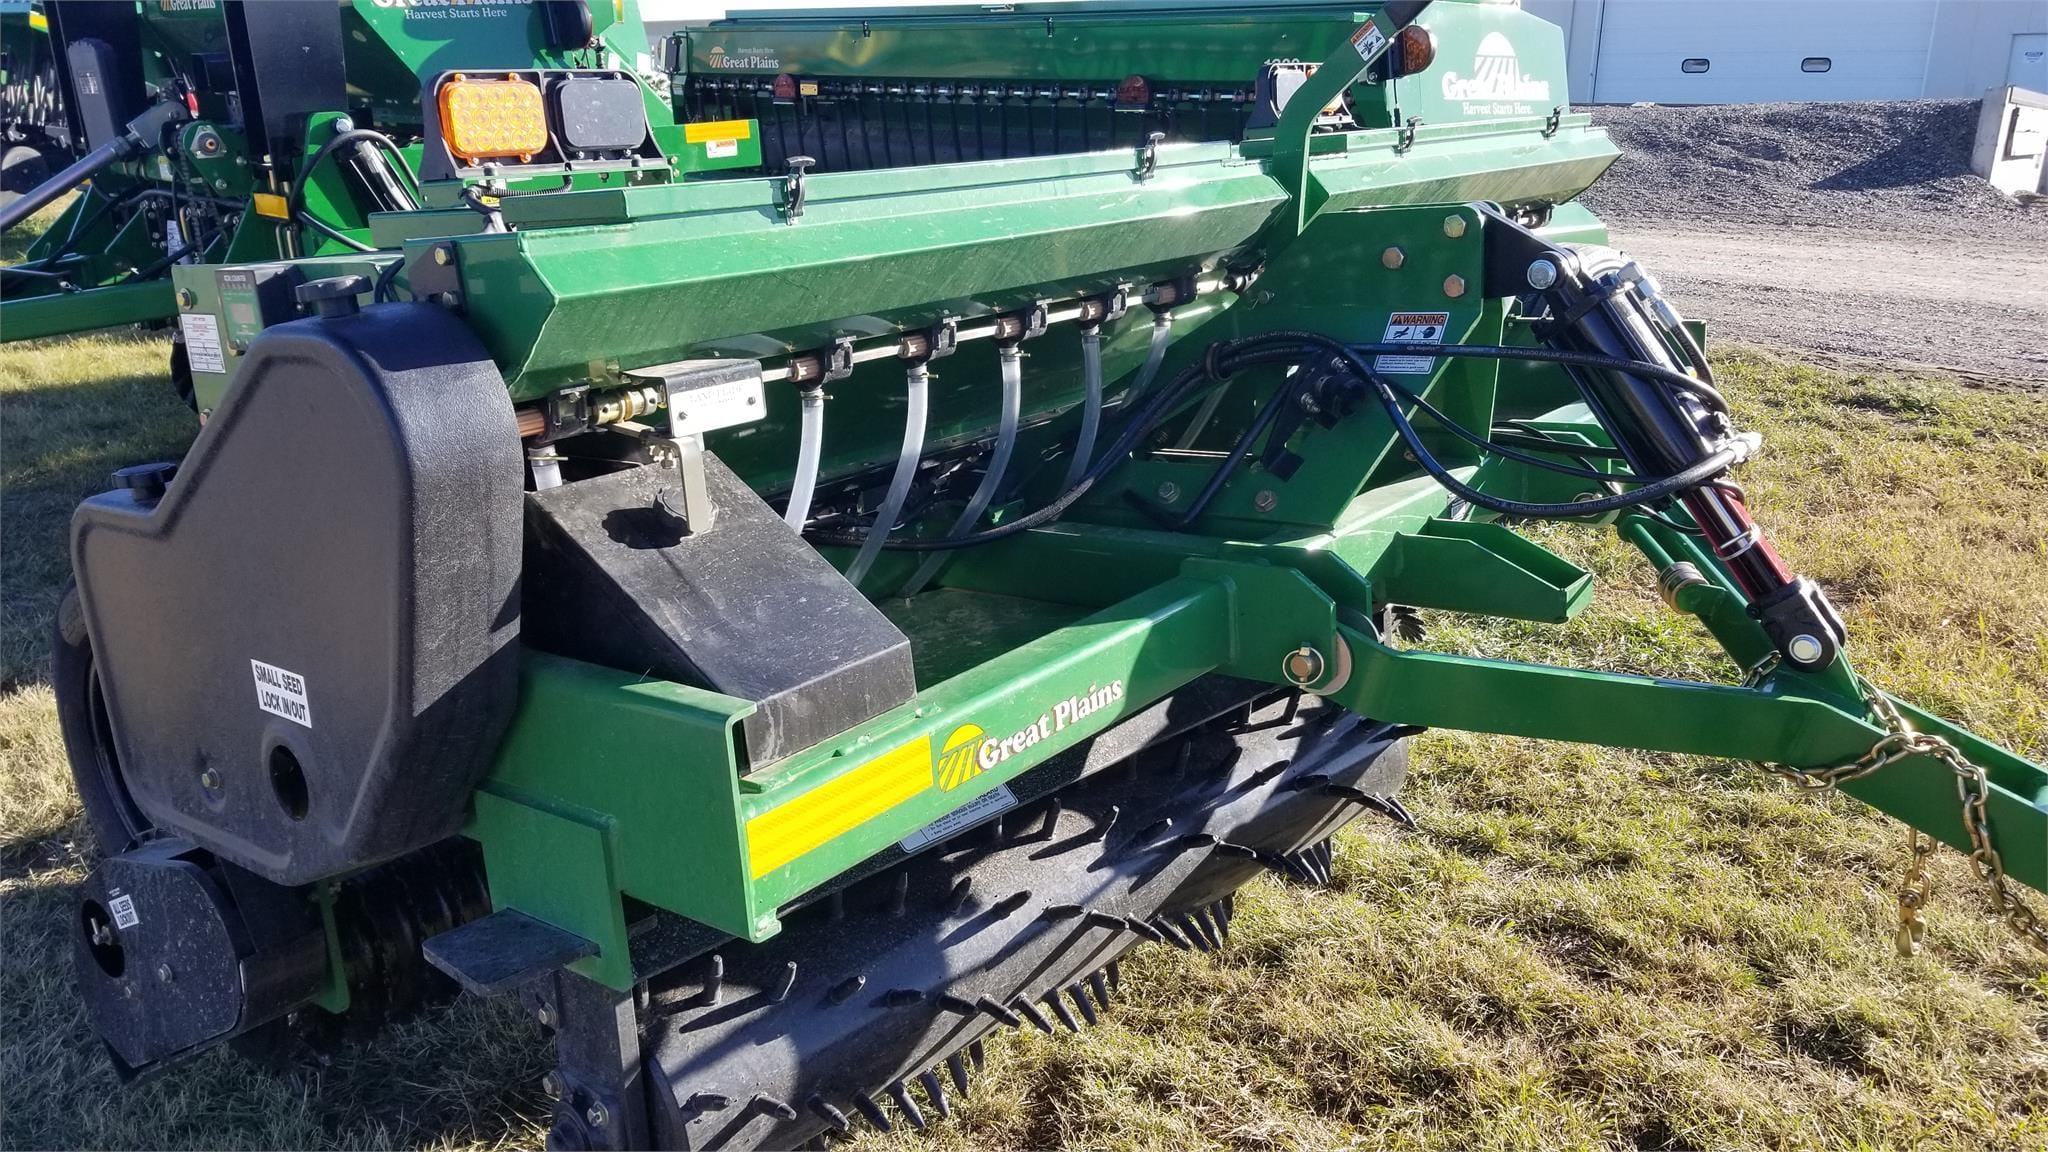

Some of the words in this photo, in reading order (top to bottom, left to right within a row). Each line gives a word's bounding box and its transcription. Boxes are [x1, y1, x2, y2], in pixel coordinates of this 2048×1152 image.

[405, 9, 447, 20] Harvest
[449, 8, 480, 18] Starts
[482, 8, 508, 17] Here
[722, 55, 751, 69] Great
[750, 55, 780, 69] Plains
[1403, 314, 1446, 325] WARNING
[255, 664, 282, 689] SMALL
[281, 672, 303, 696] SEED
[261, 689, 283, 713] LOCK
[978, 712, 1051, 770] Great
[1052, 679, 1125, 732] Plains
